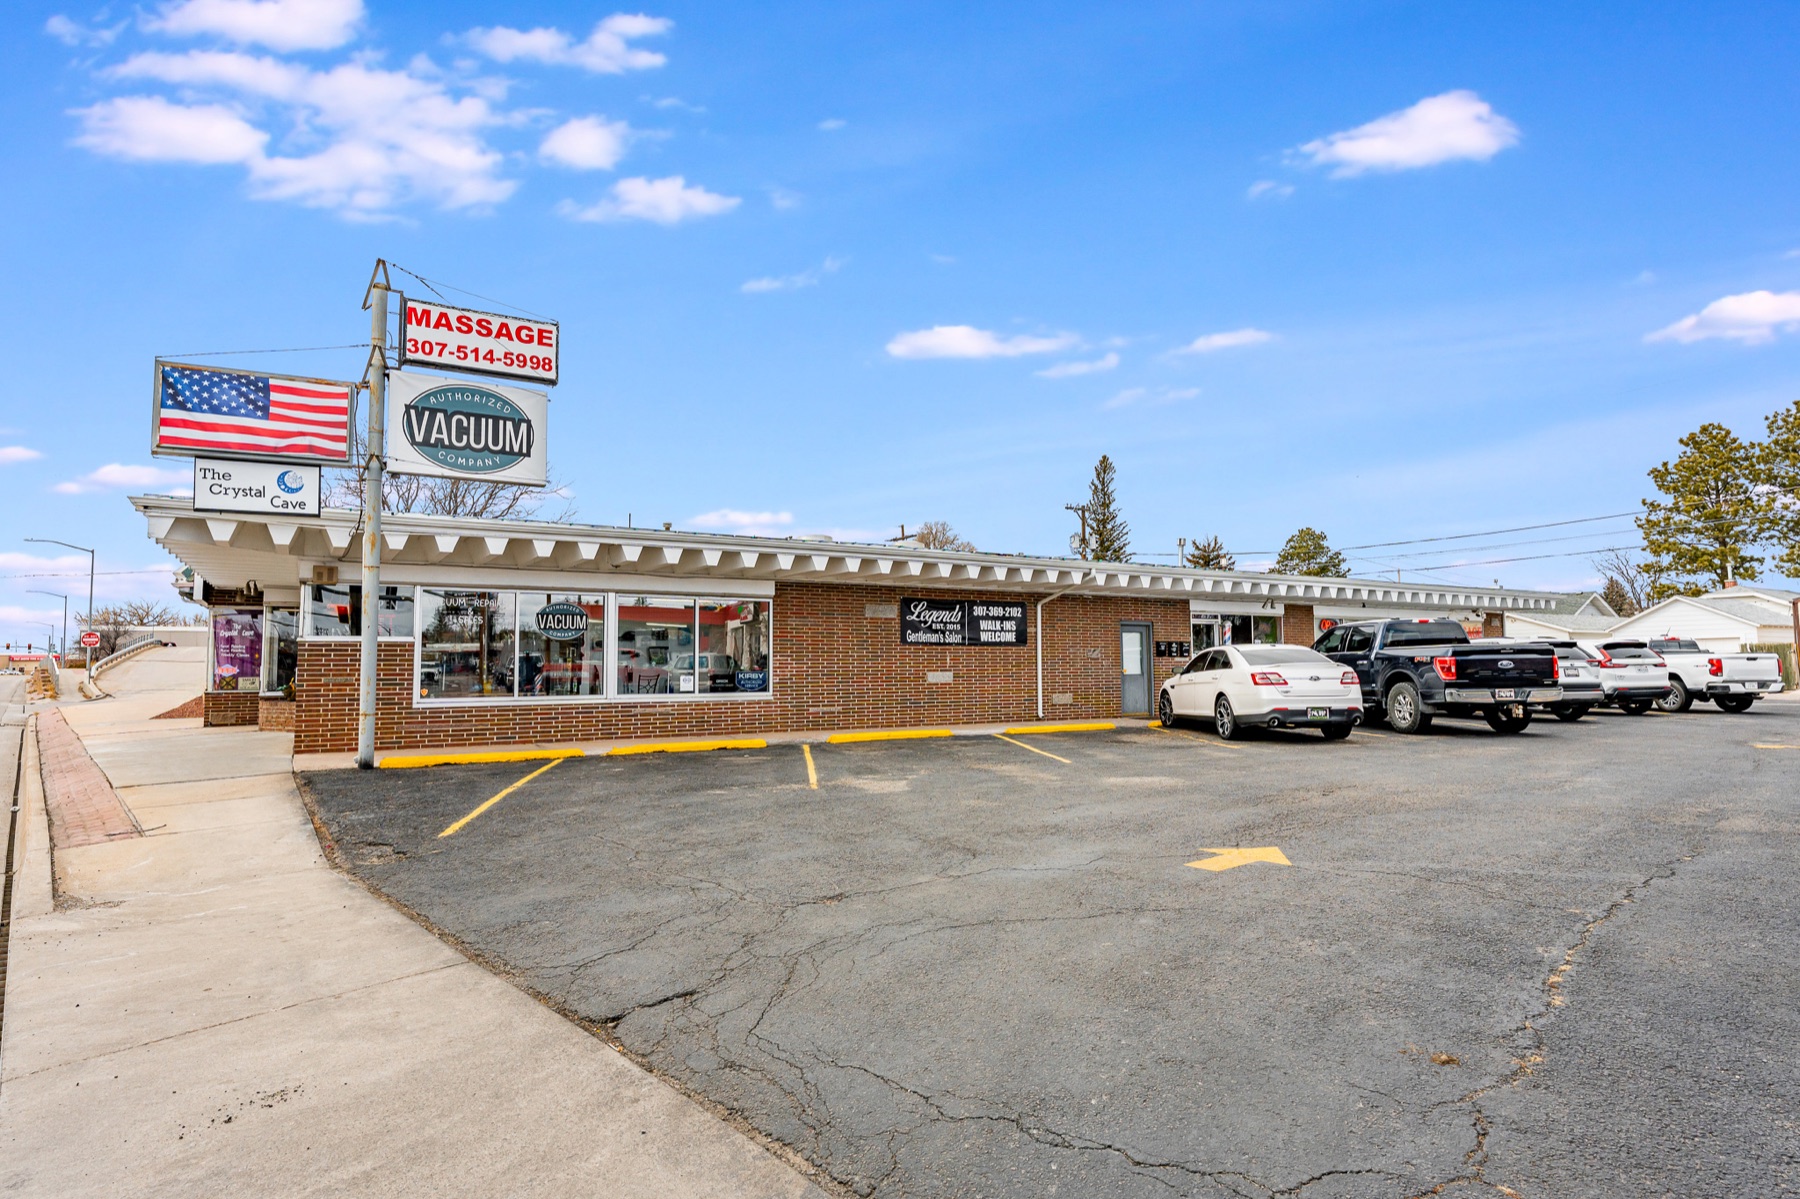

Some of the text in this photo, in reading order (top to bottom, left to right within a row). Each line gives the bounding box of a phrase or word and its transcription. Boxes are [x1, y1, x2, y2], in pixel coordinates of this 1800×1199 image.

[406, 306, 554, 348] MASSAGE
[406, 338, 553, 372] 307-514-5998
[430, 392, 511, 414] AUTHORIZED
[410, 408, 527, 453] VACUUM
[438, 451, 500, 467] COMPANY
[199, 467, 232, 481] The
[209, 483, 267, 500] Crystal
[270, 495, 307, 510] Cave
[378, 600, 398, 611] PEN
[546, 605, 580, 613] AUTHORIZED
[973, 606, 1022, 617] 307-369-2102
[538, 614, 586, 629] VACUUM
[906, 601, 962, 627] Legends
[980, 620, 1016, 631] WALK-INS
[906, 630, 962, 643] Gentleman's Salon
[980, 631, 1016, 643] WELCOME
